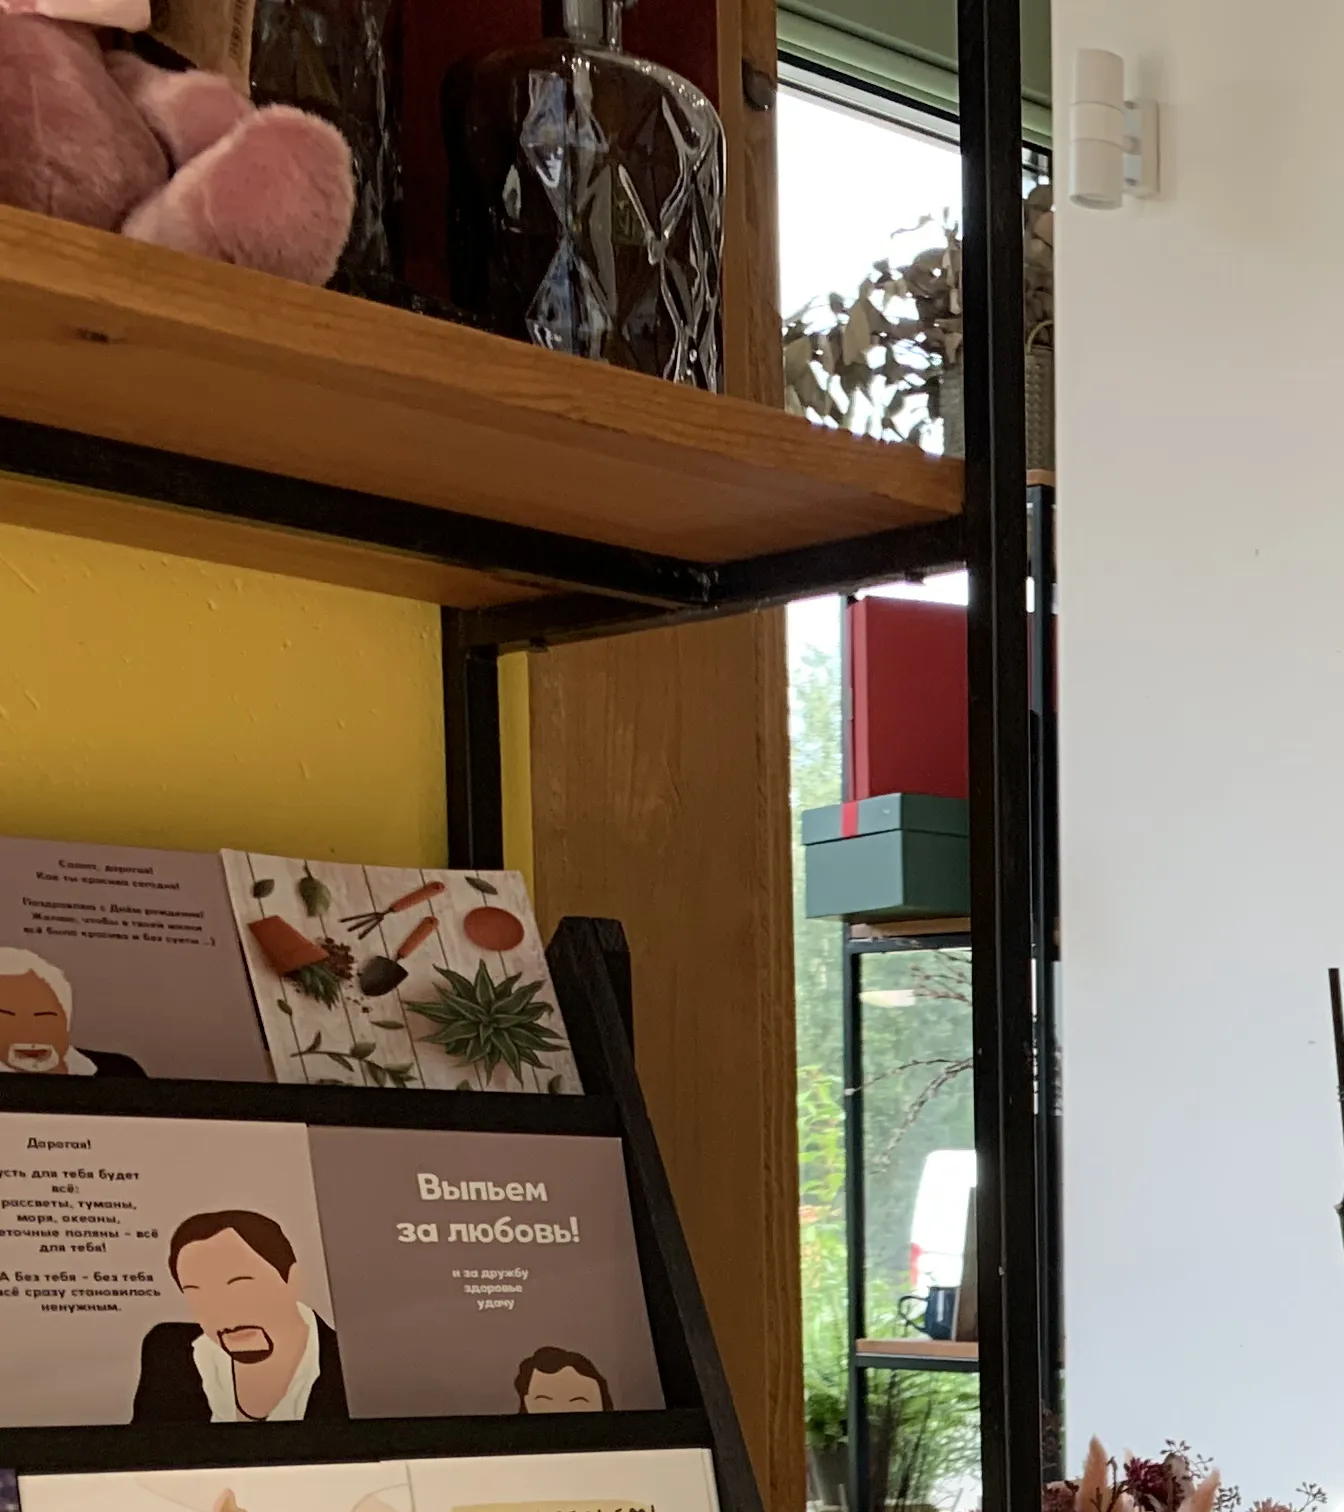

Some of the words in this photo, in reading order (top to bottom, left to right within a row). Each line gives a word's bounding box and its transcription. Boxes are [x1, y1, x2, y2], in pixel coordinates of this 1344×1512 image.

[27, 1137, 92, 1150] Дорогая!
[31, 1170, 58, 1179] для
[62, 1168, 94, 1179] тебя
[98, 1168, 139, 1181] будет
[417, 1172, 548, 1202] Выпьем
[65, 1230, 120, 1239] поляны
[136, 1229, 159, 1239] всё
[396, 1222, 439, 1244] за
[447, 1215, 581, 1244] любовь!
[39, 1243, 66, 1253] для
[70, 1242, 107, 1253] тебя!
[15, 1271, 39, 1282] без
[43, 1271, 77, 1282] тебя
[93, 1271, 118, 1282] без
[122, 1271, 154, 1282] тебя
[452, 1269, 461, 1279] и
[463, 1269, 479, 1279] за
[481, 1267, 529, 1281] дружбу
[25, 1288, 65, 1299] сразу
[71, 1288, 161, 1297] становилось
[464, 1284, 523, 1295] здоровье
[477, 1299, 515, 1310] удачу
